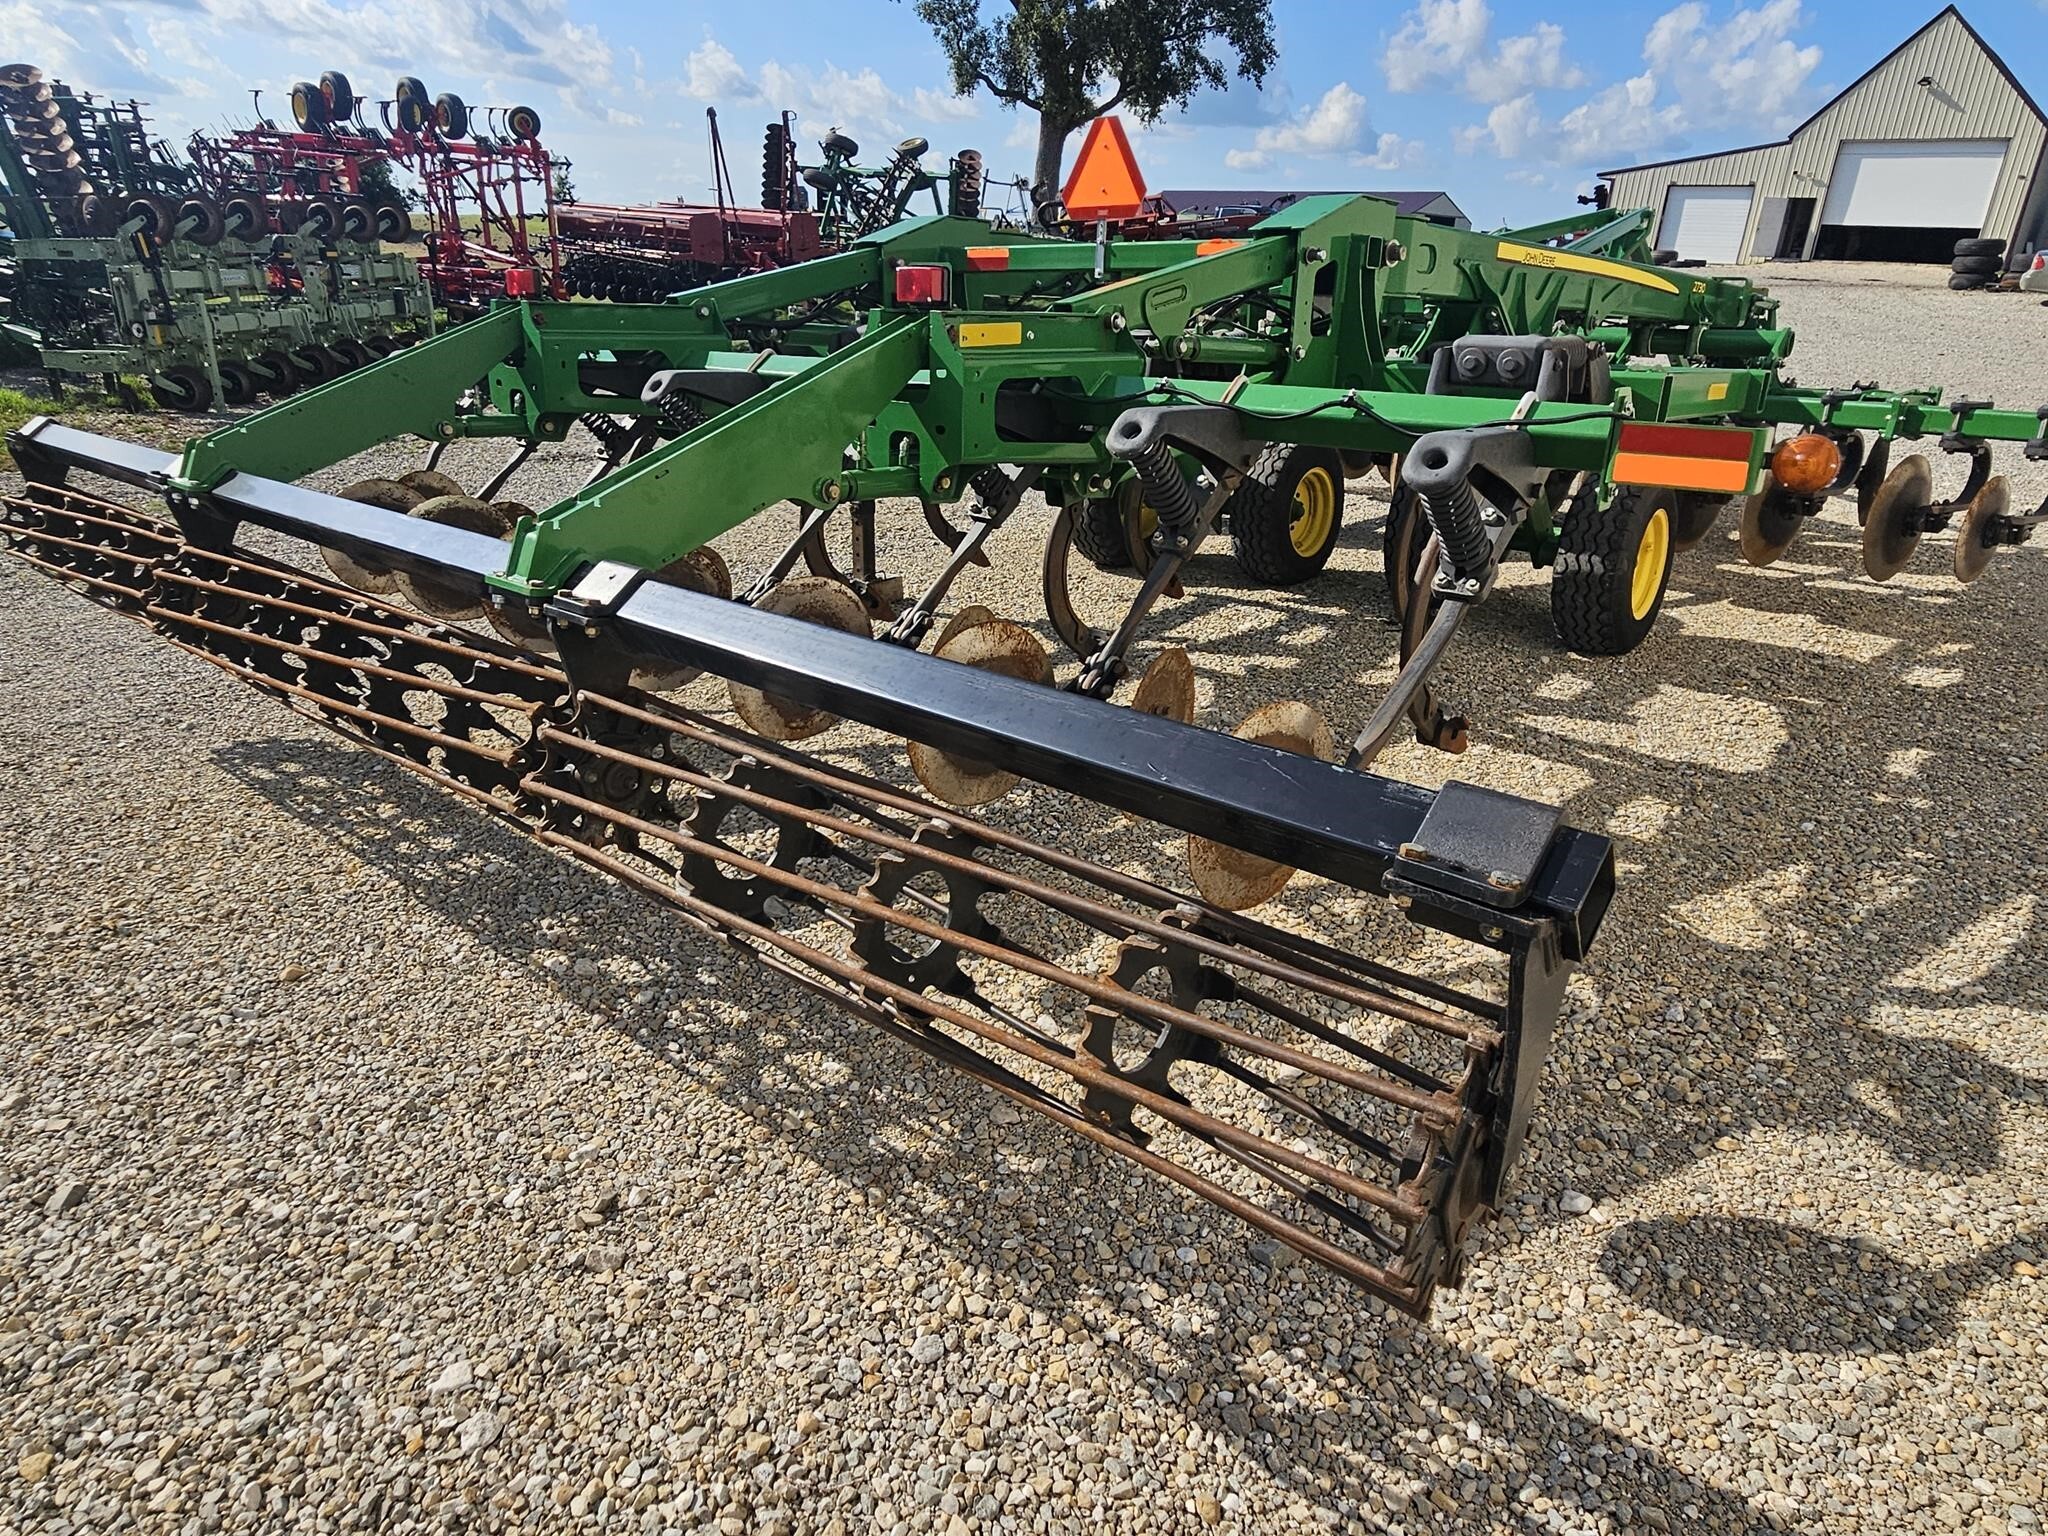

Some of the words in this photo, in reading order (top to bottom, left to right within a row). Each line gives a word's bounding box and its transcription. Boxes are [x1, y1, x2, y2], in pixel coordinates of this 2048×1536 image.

[1522, 252, 1538, 263] JOHN
[1538, 252, 1556, 266] DEERE
[1692, 281, 1706, 294] 2730
